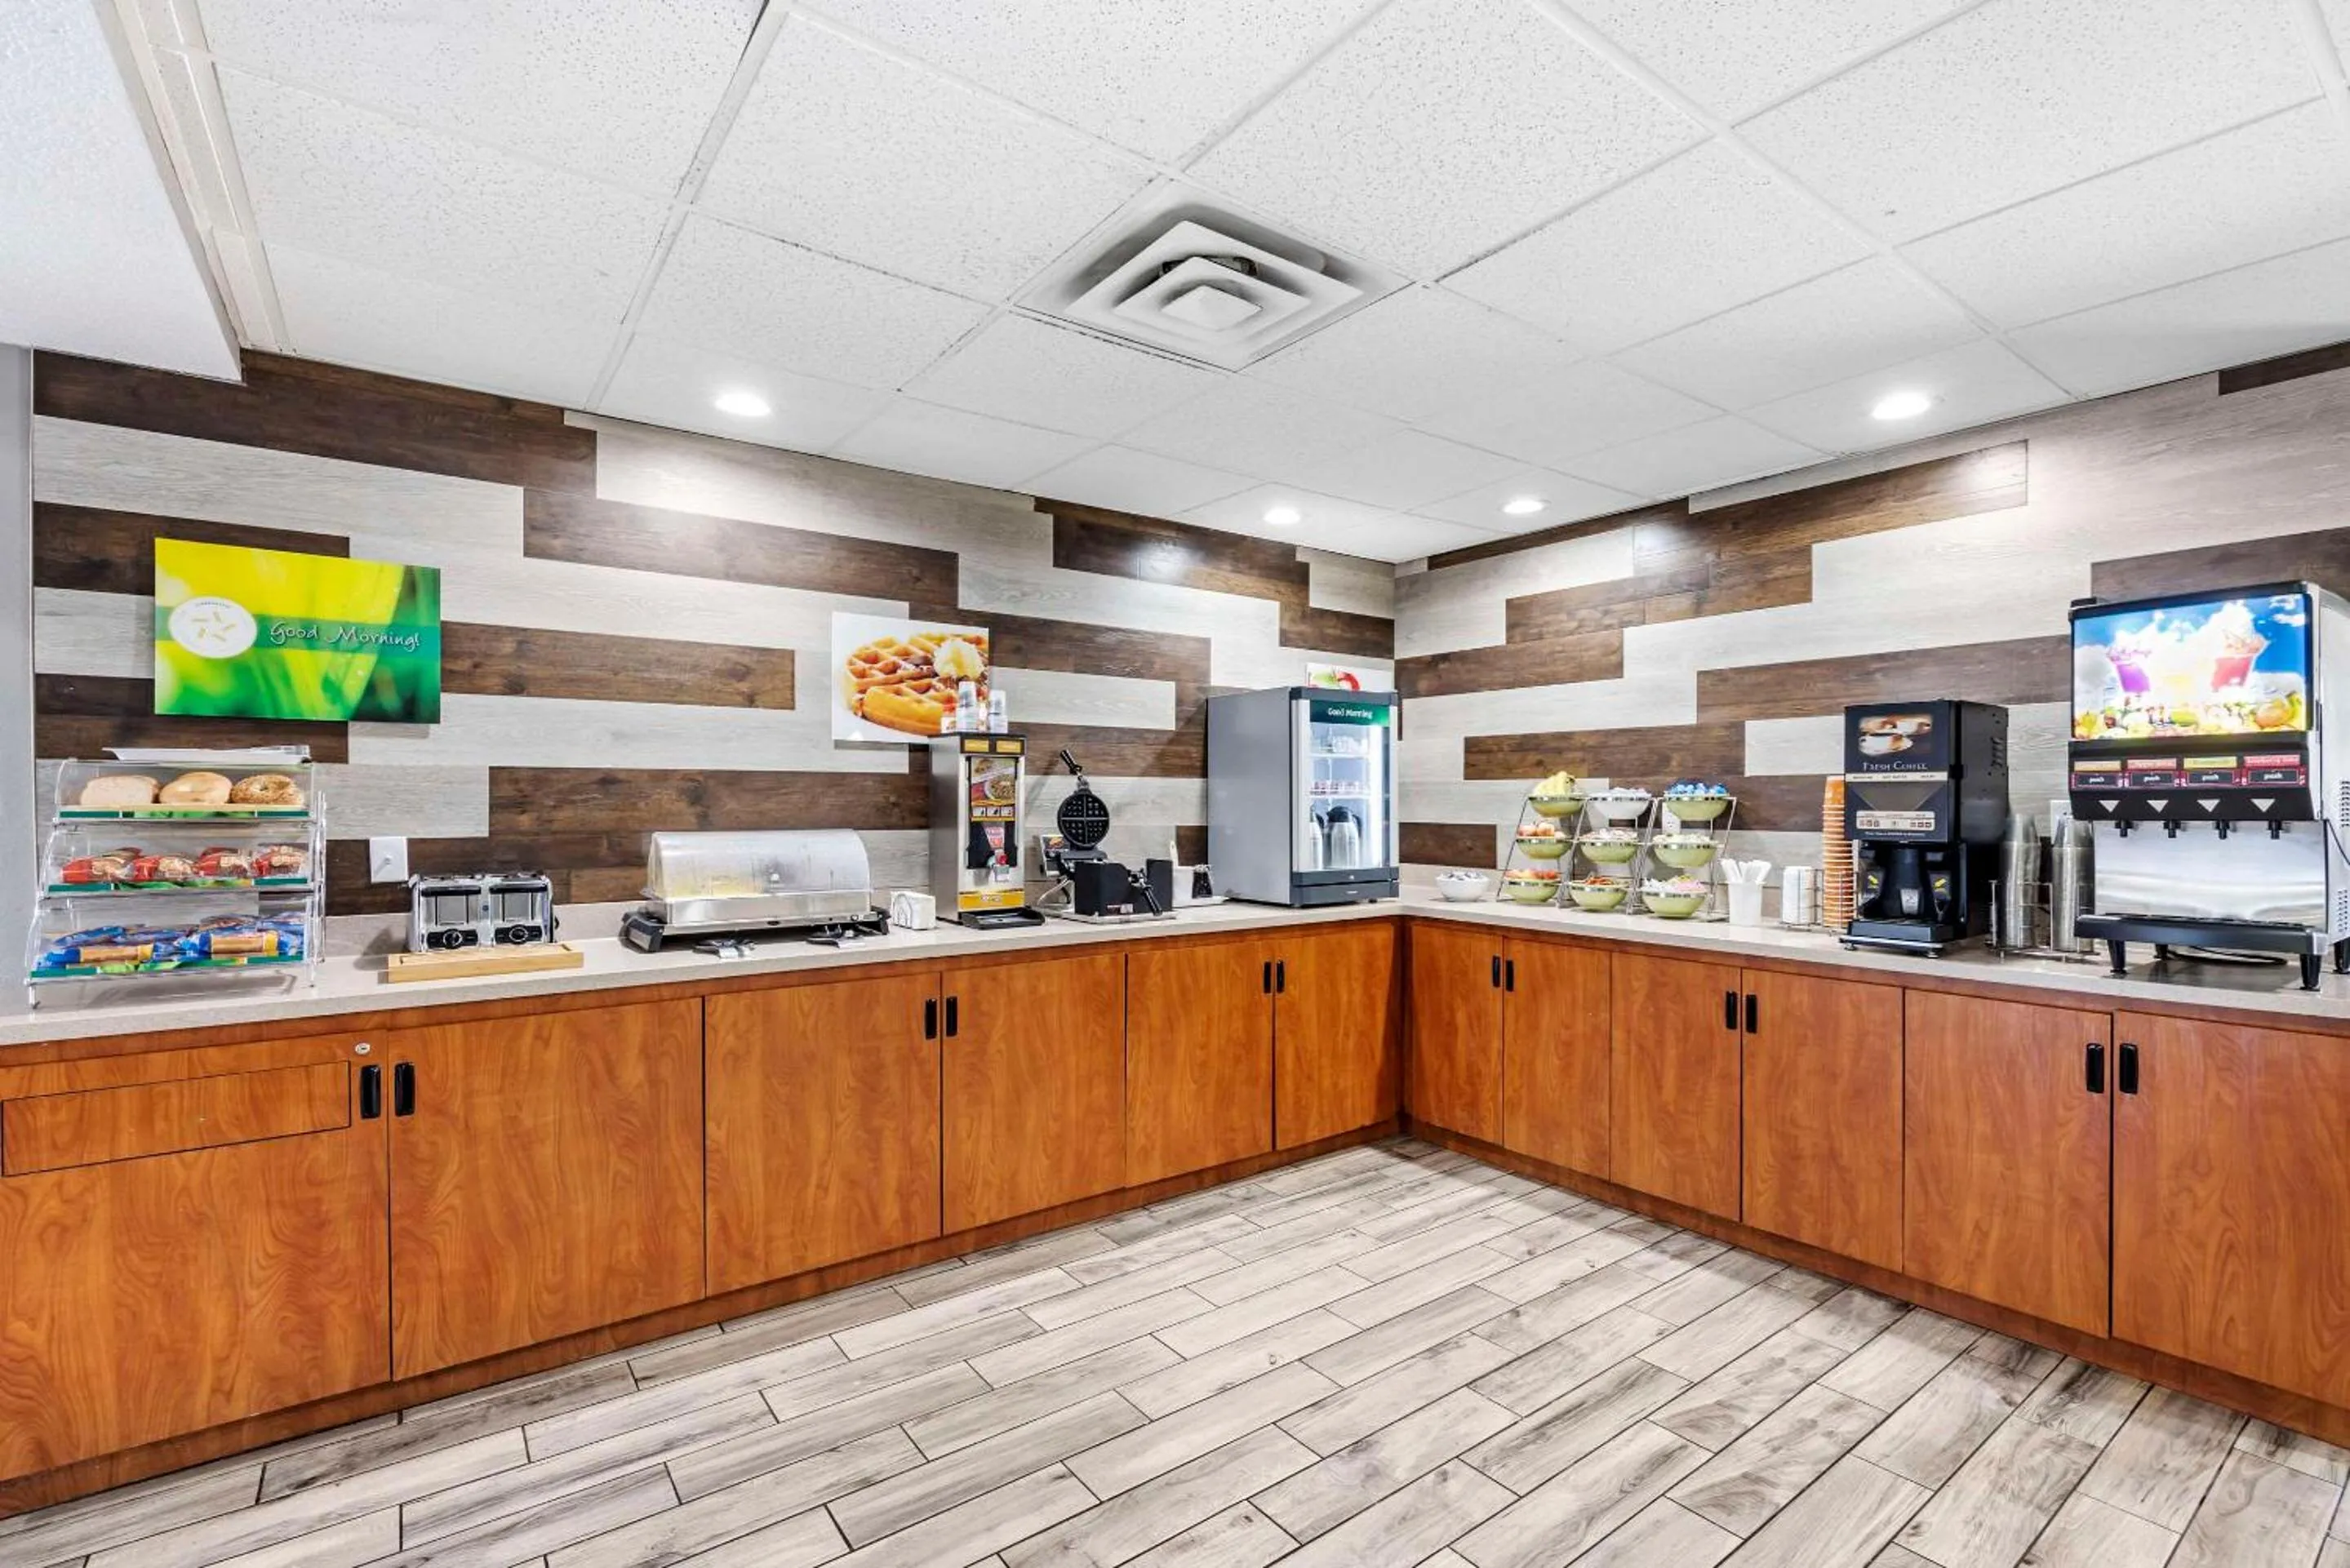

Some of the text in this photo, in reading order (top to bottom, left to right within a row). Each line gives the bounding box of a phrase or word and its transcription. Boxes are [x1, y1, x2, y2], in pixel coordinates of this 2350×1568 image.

[270, 621, 420, 652] Good Morning!
[1327, 707, 1344, 717] Good
